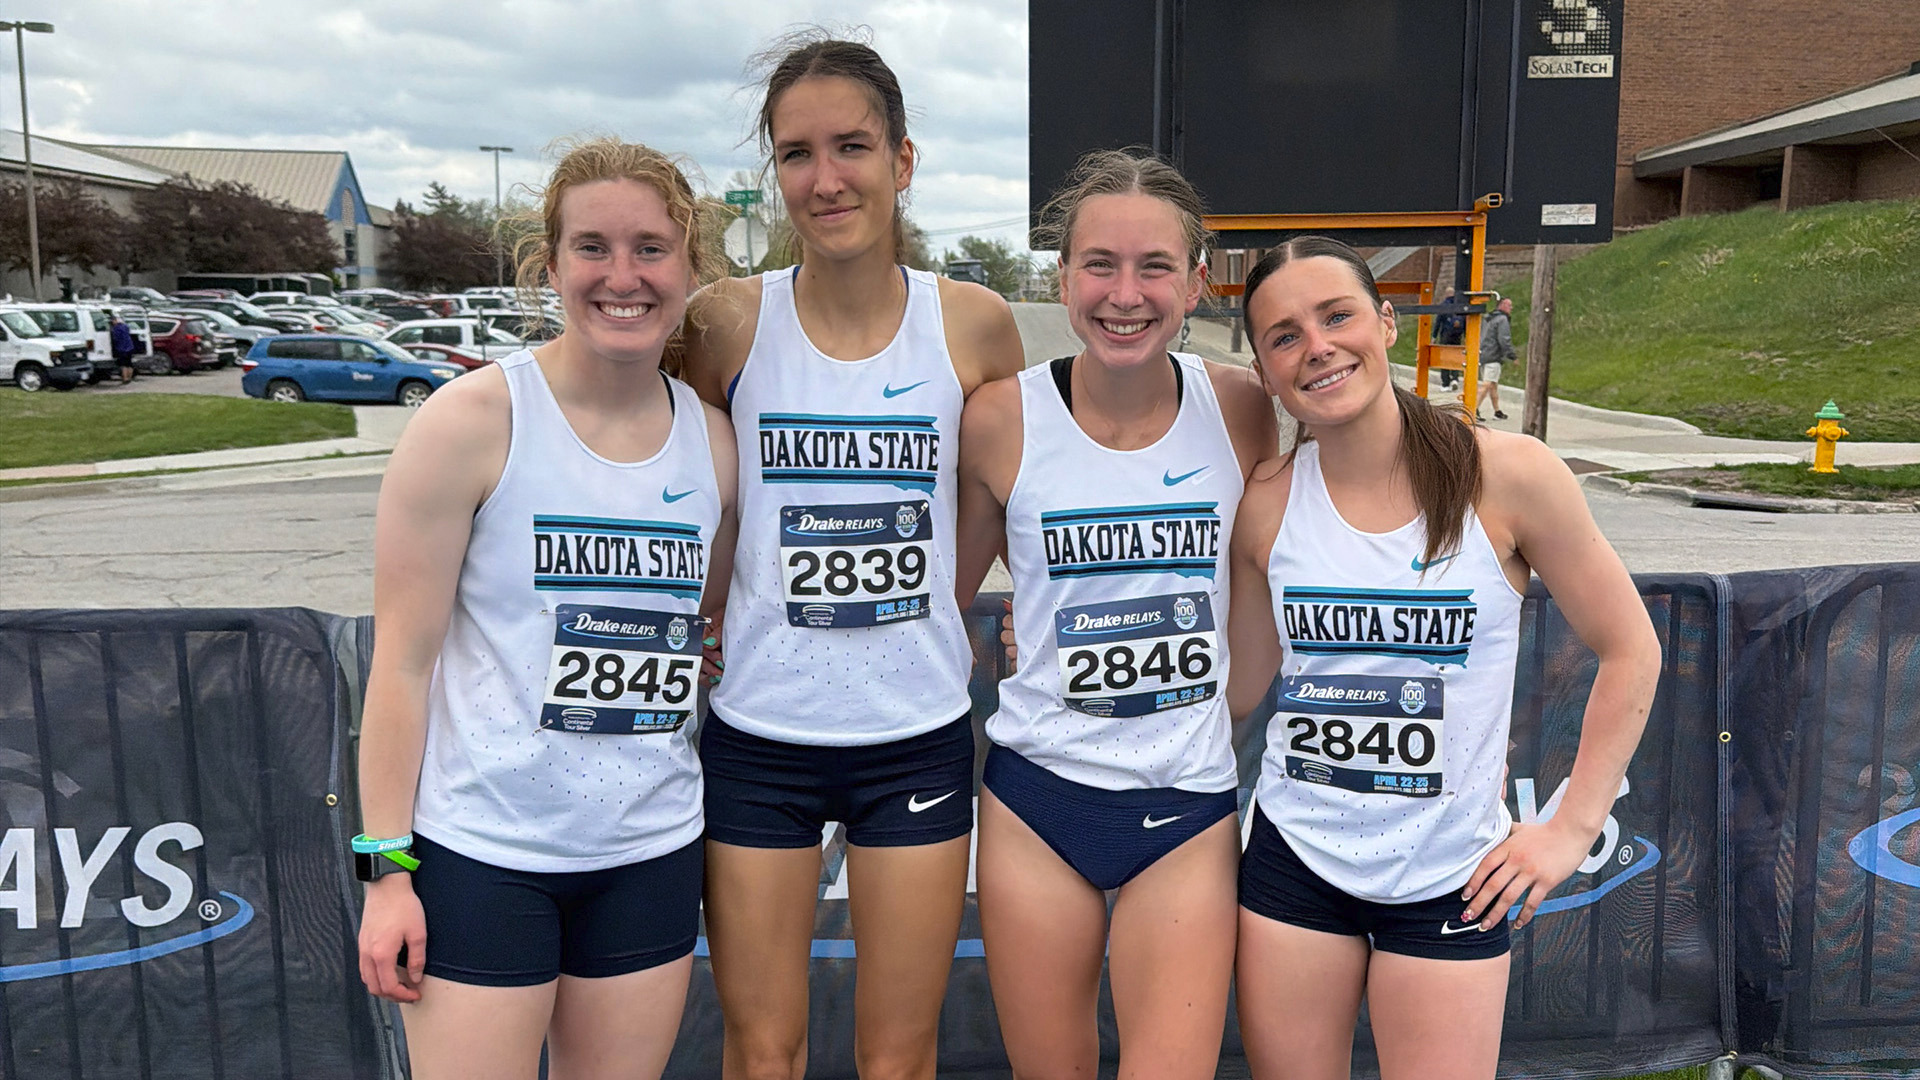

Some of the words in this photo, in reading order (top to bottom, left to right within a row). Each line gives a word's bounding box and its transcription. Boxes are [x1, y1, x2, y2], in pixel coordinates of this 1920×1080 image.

[759, 430, 862, 469] DAKOTA
[868, 432, 940, 471] STATE
[797, 514, 845, 532] Drake
[845, 517, 884, 531] RELAYS
[898, 513, 915, 525] 100
[1043, 523, 1146, 566] DAKOTA
[1152, 520, 1221, 559] STATE
[534, 534, 643, 577] DAKOTA
[649, 539, 704, 580] STATE
[788, 545, 926, 596] 2839
[876, 602, 896, 616] APRIL
[897, 599, 920, 612] 22-25
[1176, 604, 1194, 617] 100
[573, 612, 621, 634] Drake
[620, 622, 657, 637] RELAYS
[1073, 613, 1123, 632] Drake
[1123, 610, 1162, 625] RELAYS
[1283, 604, 1387, 642] DAKOTA
[1393, 607, 1478, 645] STATE
[669, 626, 686, 637] 100
[1067, 637, 1213, 693] 2846
[553, 650, 695, 705] 2845
[1156, 691, 1179, 705] APRIL
[1180, 686, 1206, 701] 22-25
[1296, 682, 1346, 700] Drake
[1346, 689, 1386, 702] RELAYS
[1403, 689, 1422, 701] 100
[563, 717, 594, 726] Continental
[634, 713, 655, 725] APRIL
[656, 714, 680, 725] 22-25
[1287, 717, 1436, 767] 2840
[1374, 774, 1399, 787] APRIL
[1400, 776, 1429, 788] 22-25
